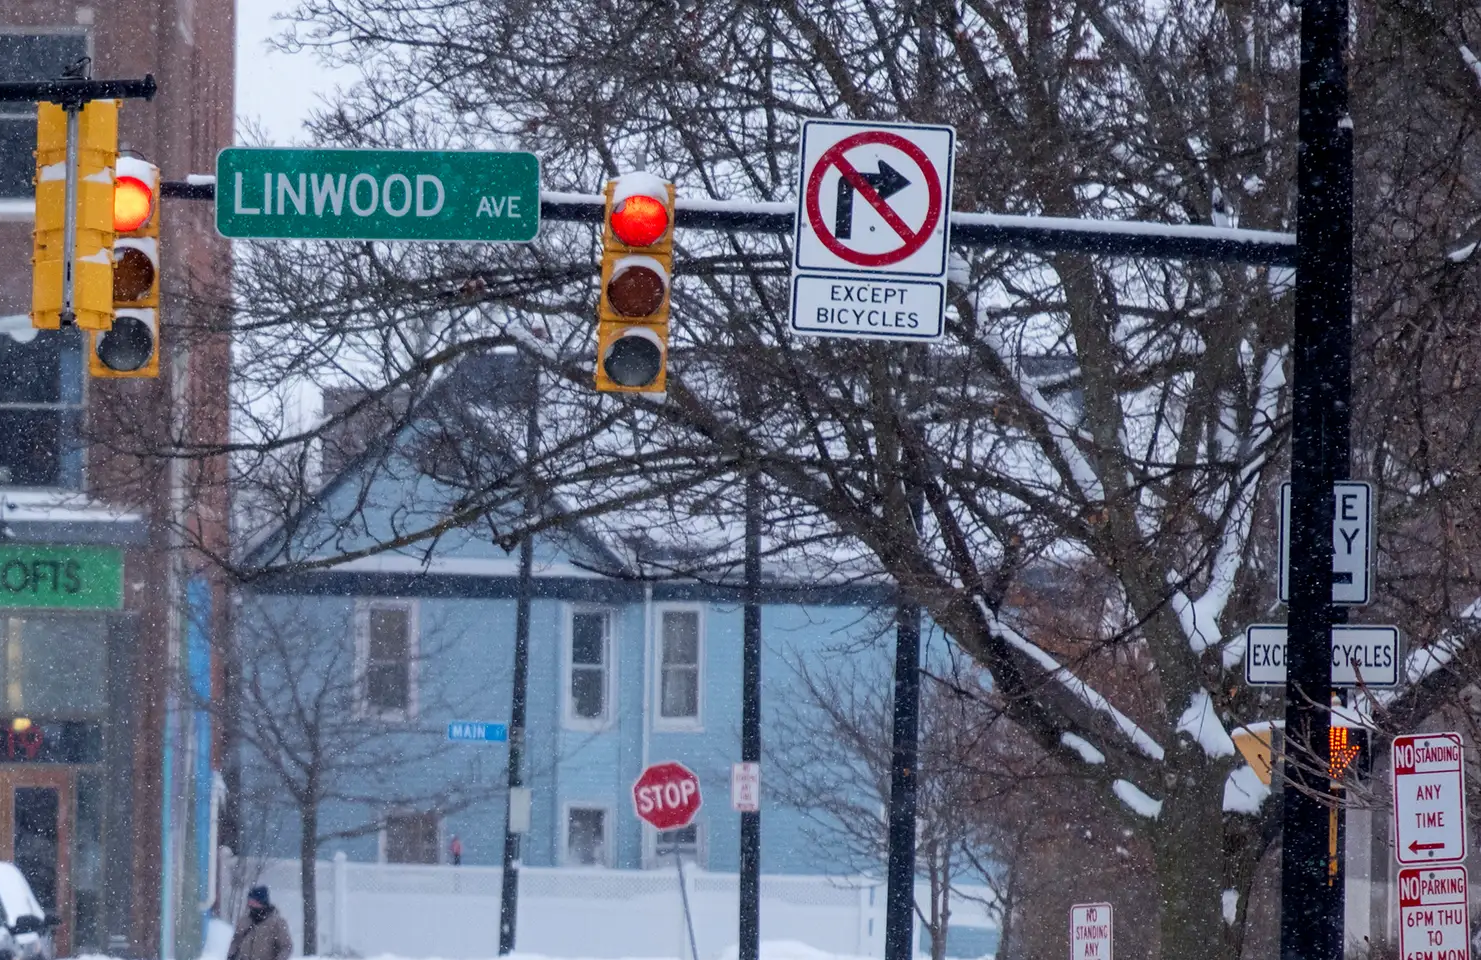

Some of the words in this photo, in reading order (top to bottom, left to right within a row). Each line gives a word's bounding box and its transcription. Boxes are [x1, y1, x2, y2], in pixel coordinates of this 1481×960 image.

[234, 171, 445, 217] LINWOOD
[476, 196, 521, 218] AVE
[831, 285, 908, 304] EXCEPT
[816, 307, 919, 329] BICYCLES
[1332, 644, 1392, 668] CYCLES
[452, 724, 485, 738] MAIN
[1395, 744, 1414, 769] NO
[1415, 746, 1458, 763] STANDING
[638, 780, 696, 813] STOP
[1416, 784, 1441, 801] ANY
[1415, 812, 1444, 828] TIME
[1400, 877, 1420, 900] NO
[1421, 878, 1464, 896] PARKING
[1086, 908, 1097, 923] NO
[1407, 911, 1434, 927] 6PM
[1438, 909, 1462, 925] THU
[1076, 925, 1108, 940] STANDING
[1427, 930, 1443, 946] TO
[1084, 942, 1099, 957] ANY
